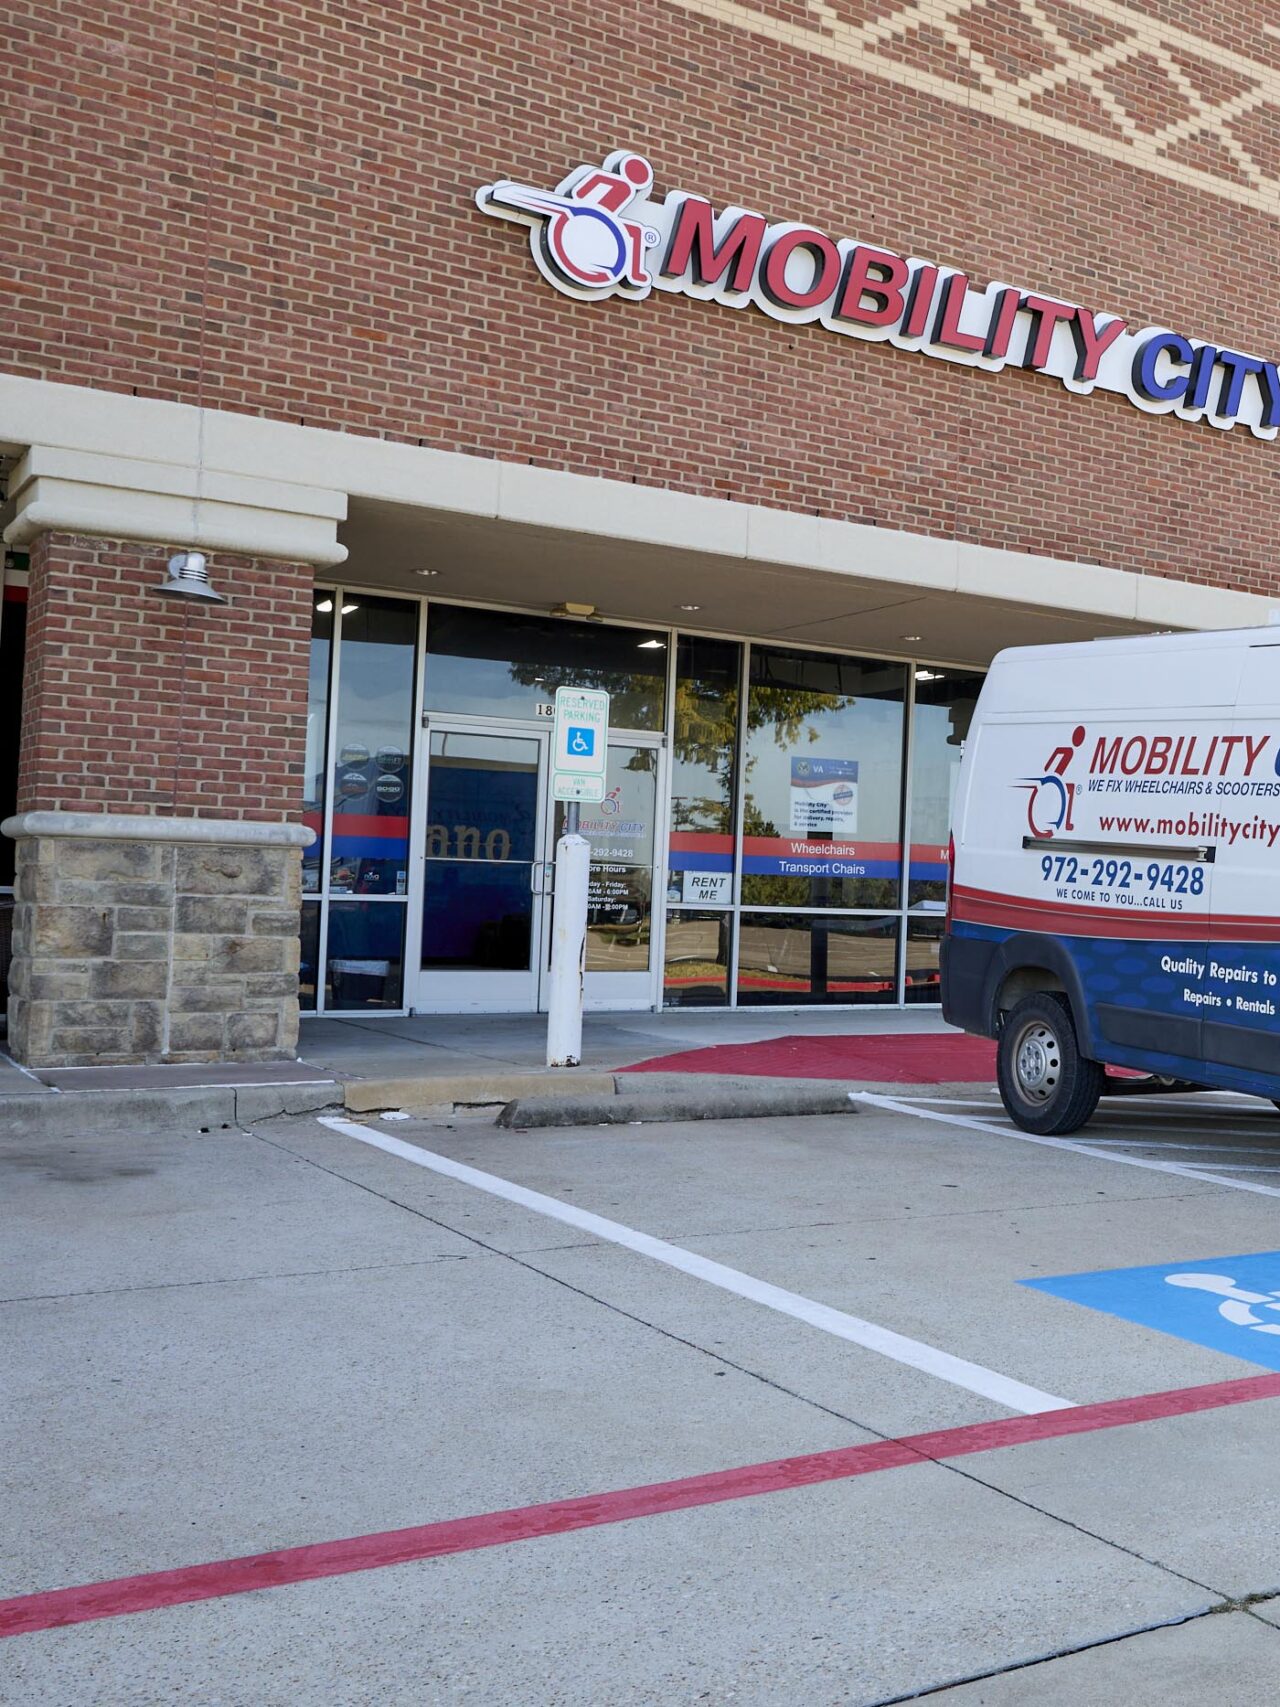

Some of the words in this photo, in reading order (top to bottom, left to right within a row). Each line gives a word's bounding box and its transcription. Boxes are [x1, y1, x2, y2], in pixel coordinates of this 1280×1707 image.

[662, 198, 1128, 383] MOBILITY
[537, 704, 556, 716] 18
[559, 696, 606, 711] RESERVED
[563, 709, 601, 722] PARKING
[1089, 735, 1271, 777] MOBILITY
[812, 765, 824, 774] VA
[573, 776, 586, 785] VAN
[1088, 779, 1105, 792] WE
[1105, 780, 1123, 793] FIX
[1124, 780, 1204, 795] WHEELCHAIRS
[1205, 782, 1212, 795] &
[558, 787, 600, 797] ACCESIBLE
[562, 818, 618, 832] MBILITY
[620, 823, 645, 833] CITY
[590, 848, 634, 858] -292-9428
[790, 842, 856, 856] Wheelchairs
[602, 865, 627, 873] Hours
[779, 861, 830, 876] Transport
[832, 862, 866, 876] Chairs
[1041, 855, 1204, 895] 972-292-9428
[691, 877, 727, 888] RENT
[698, 890, 718, 900] ME
[1056, 887, 1068, 899] WE
[1071, 889, 1096, 902] COME
[1100, 892, 1111, 903] TO
[1170, 899, 1183, 910] US
[1161, 955, 1205, 979] Quality
[1209, 961, 1258, 983] Repairs
[1263, 970, 1277, 986] to
[1183, 988, 1222, 1007] Repairs
[1236, 996, 1276, 1015] Rentals
